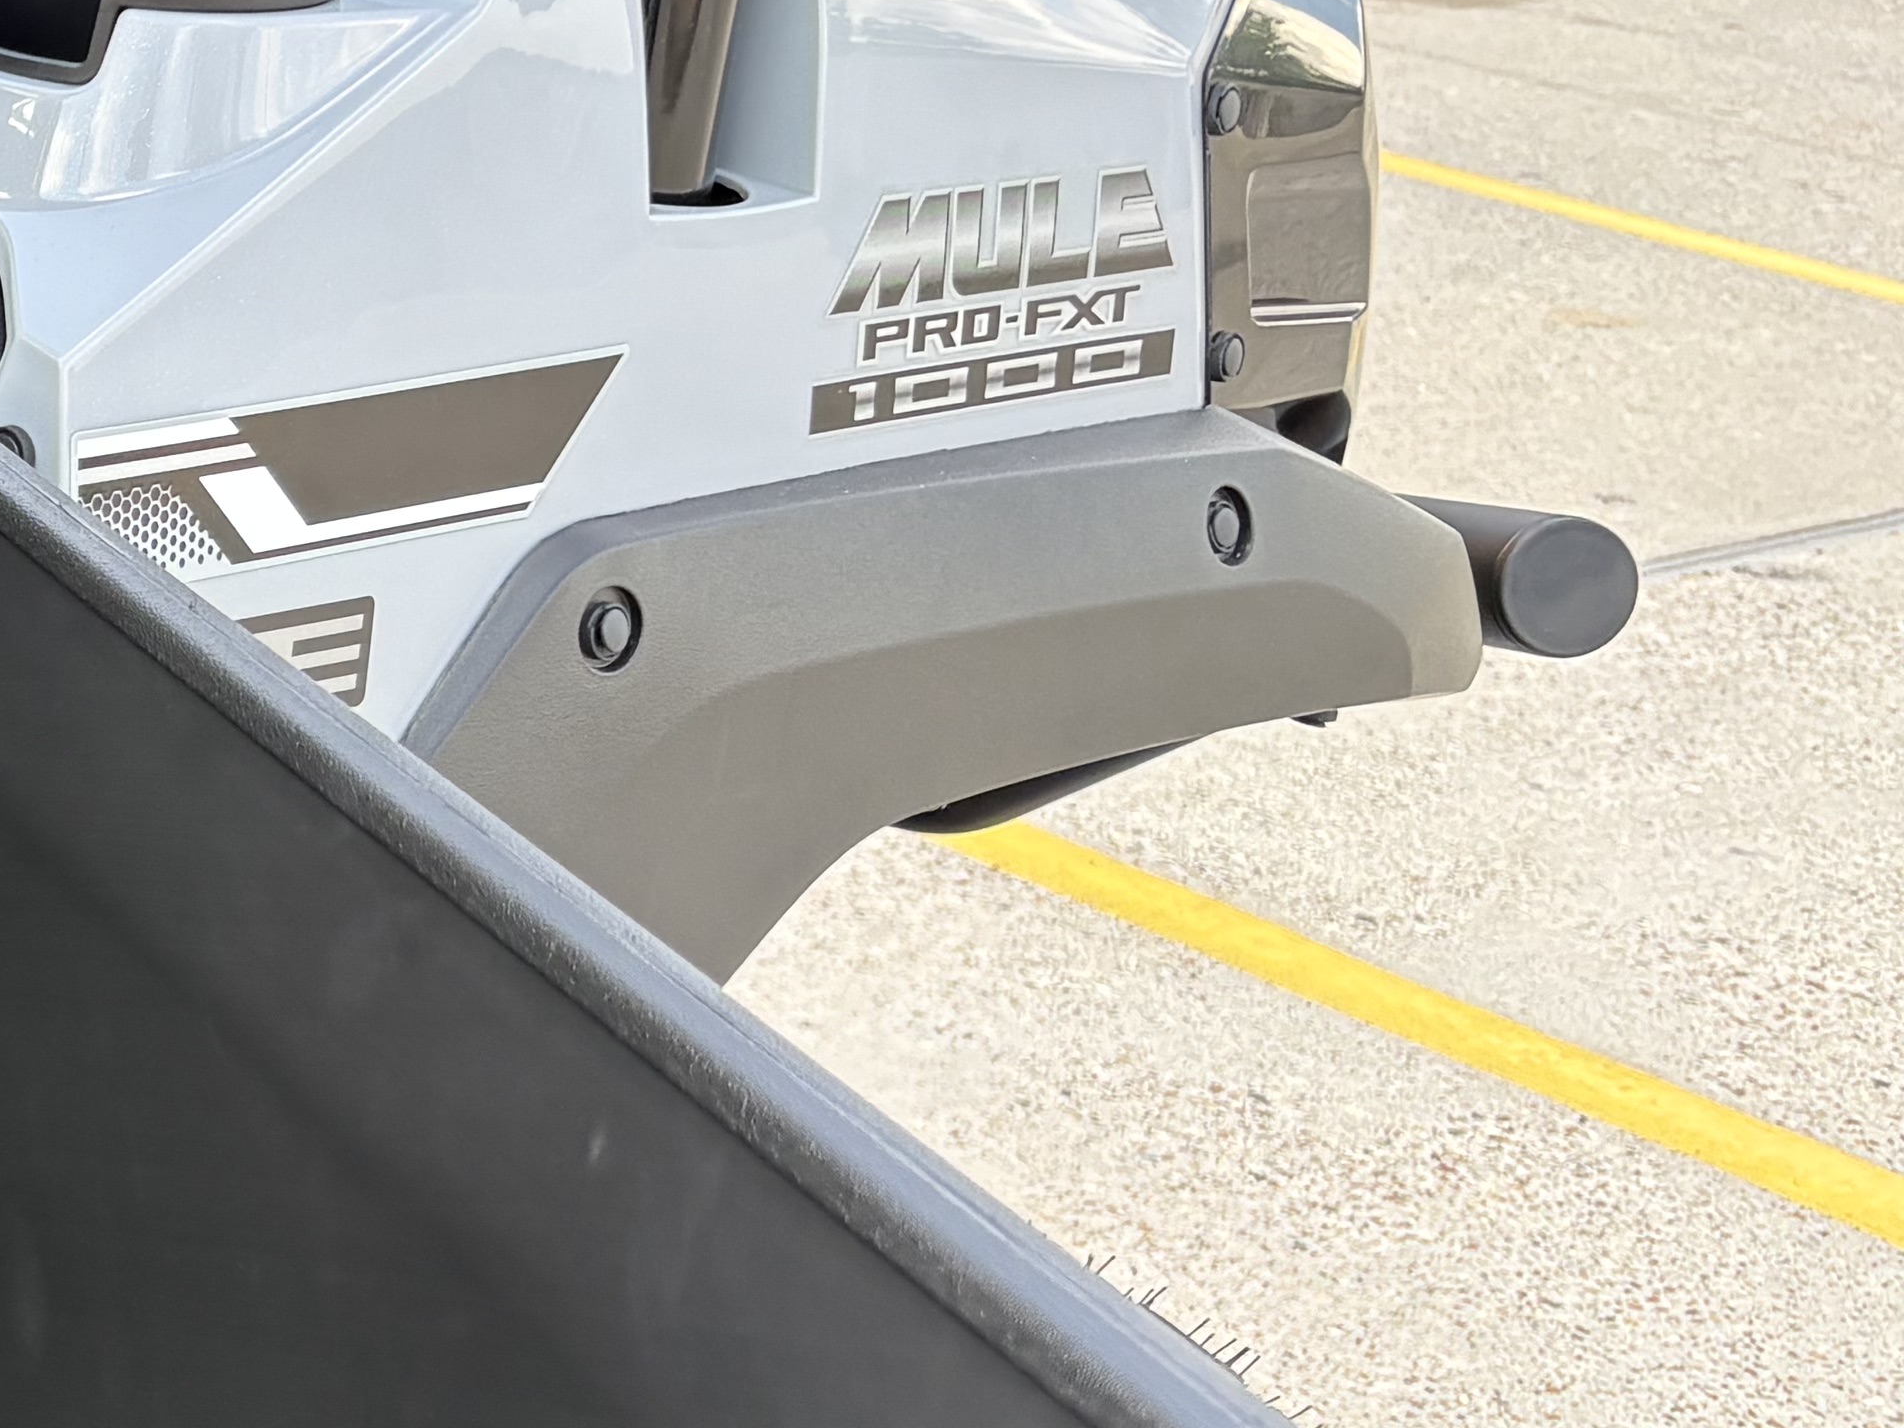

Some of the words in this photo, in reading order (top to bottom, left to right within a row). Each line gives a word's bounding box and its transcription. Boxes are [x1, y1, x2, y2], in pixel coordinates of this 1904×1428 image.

[826, 167, 1175, 316] MULE
[860, 282, 1143, 364] PRO-FXT
[847, 338, 1145, 424] 1000
